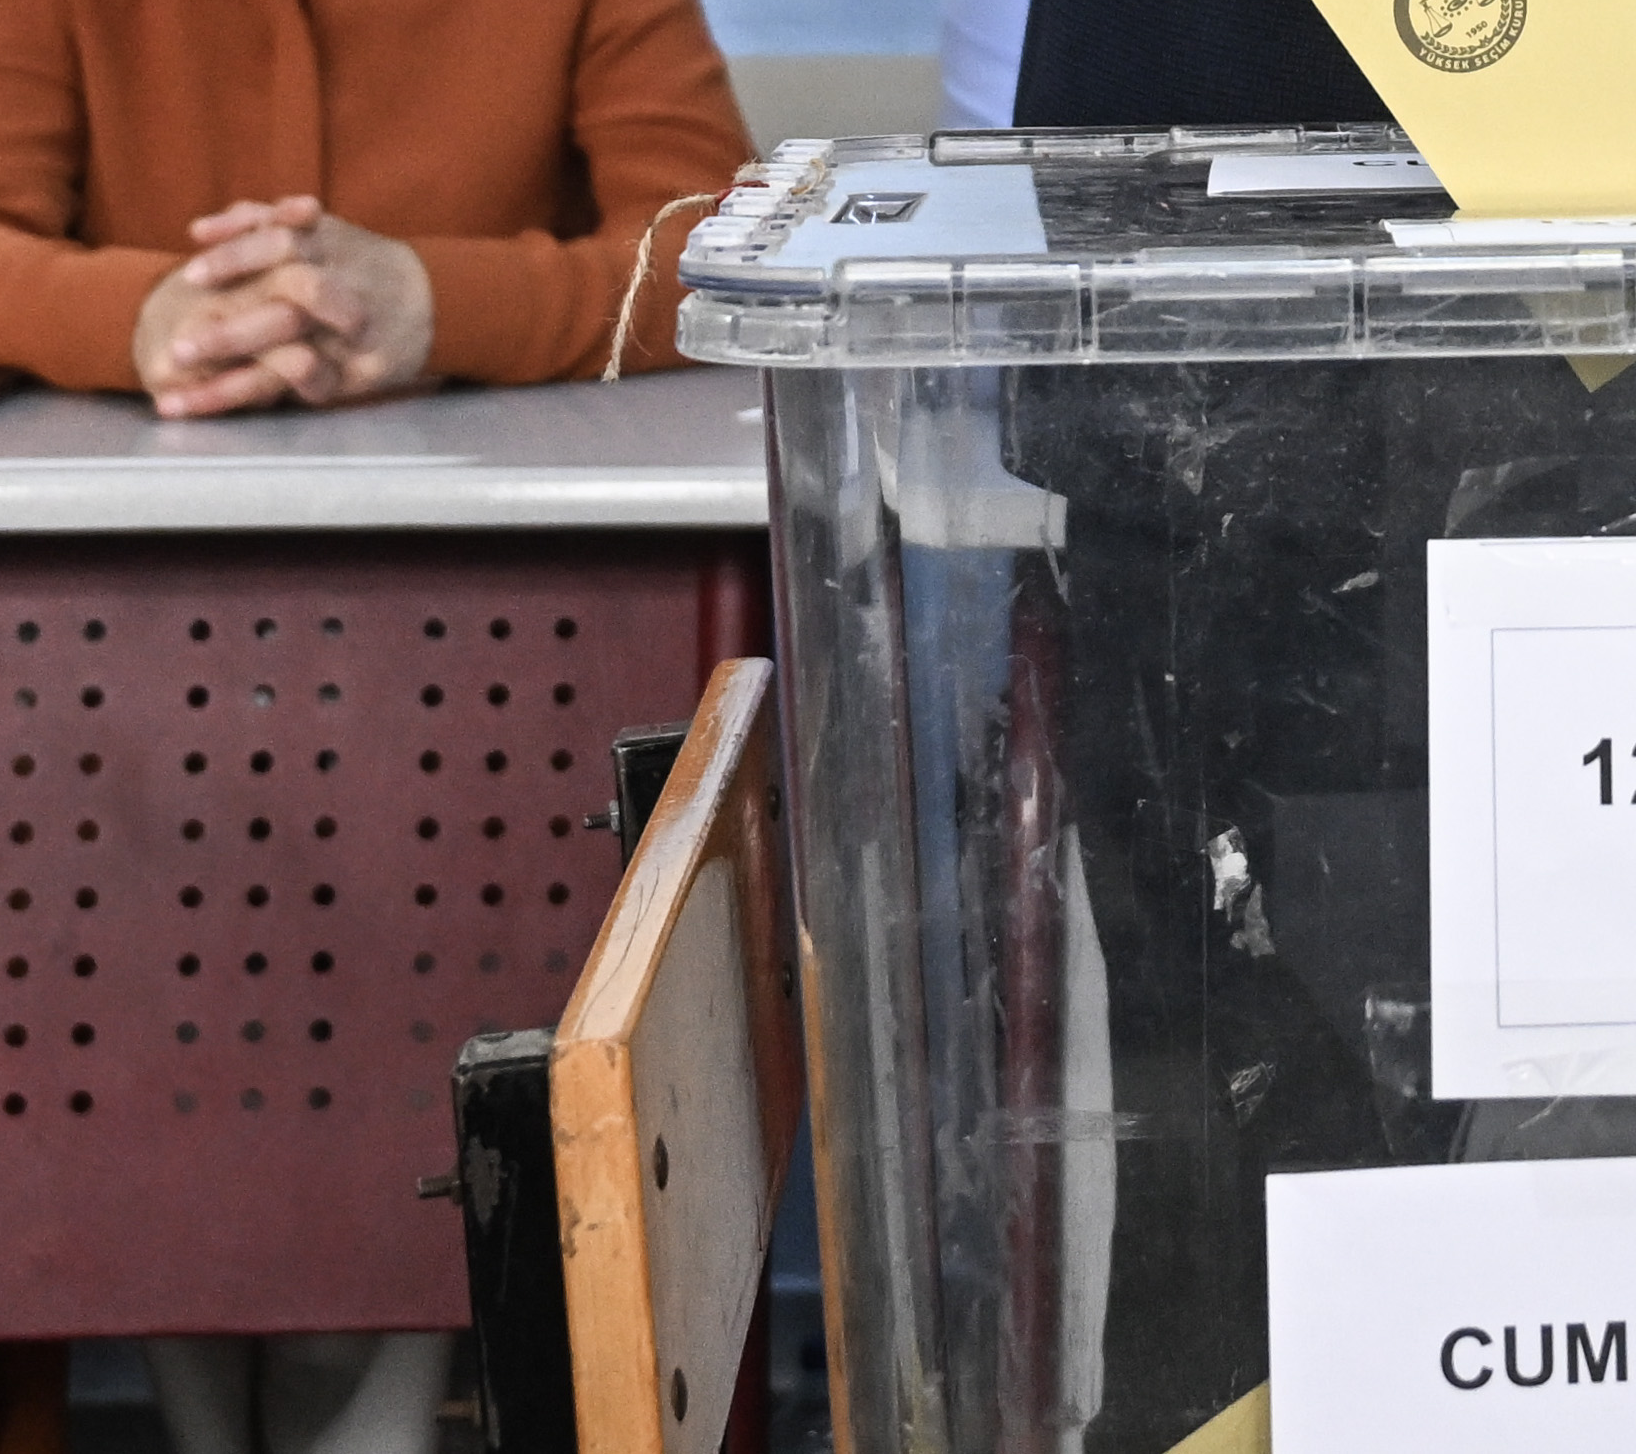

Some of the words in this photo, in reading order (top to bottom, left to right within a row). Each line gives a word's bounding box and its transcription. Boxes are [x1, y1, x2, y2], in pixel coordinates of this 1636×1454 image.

[1465, 20, 1489, 39] 1950
[1418, 47, 1470, 70] YÜKSEK
[1474, 38, 1511, 68] SEÇİM
